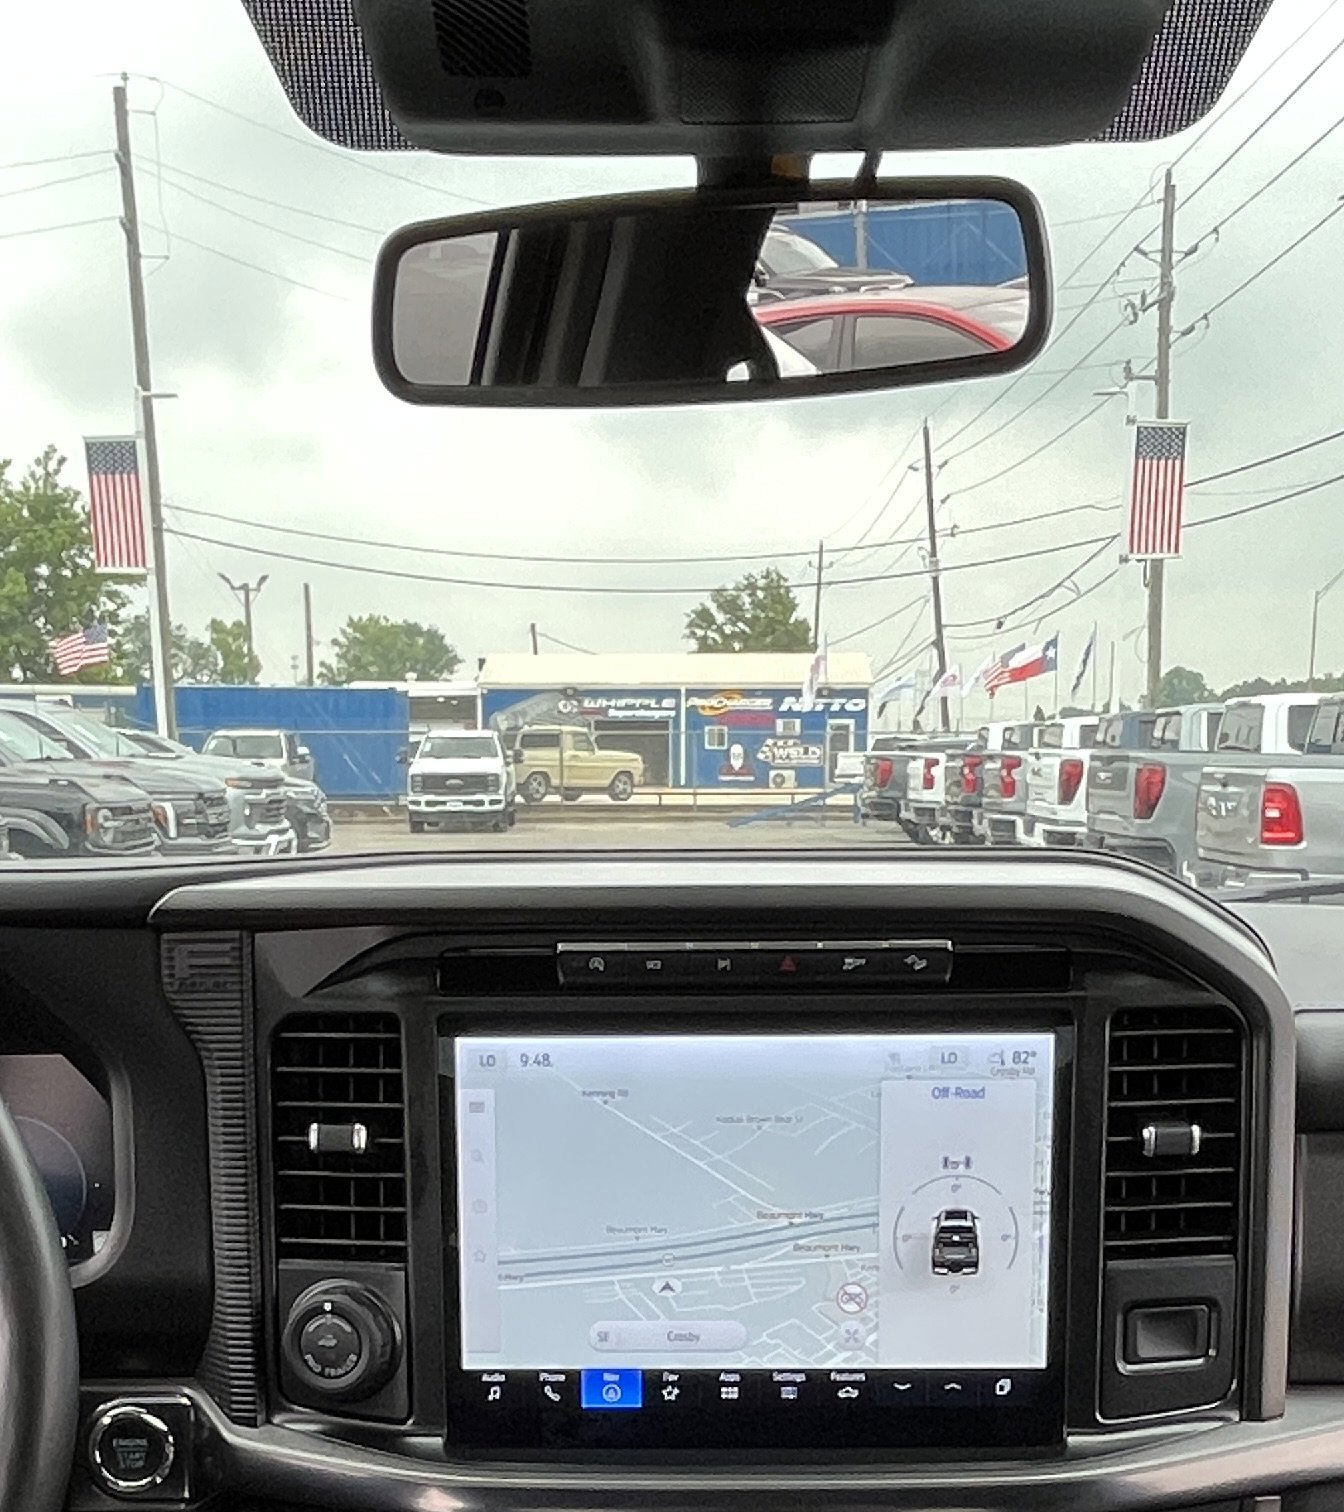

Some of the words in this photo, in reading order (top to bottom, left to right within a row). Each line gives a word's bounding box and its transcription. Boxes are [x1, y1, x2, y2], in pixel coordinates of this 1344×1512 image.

[582, 698, 676, 709] WHIPPLE
[778, 696, 866, 713] NITTO
[478, 1055, 496, 1068] LO
[940, 1052, 958, 1065] LO
[931, 1086, 987, 1100] Off-Road
[756, 1210, 803, 1220] Beaumont
[804, 1210, 825, 1222] Hwy
[792, 1243, 839, 1253] Beaumont
[840, 1243, 861, 1255] Hwy
[666, 1331, 701, 1344] Crosby
